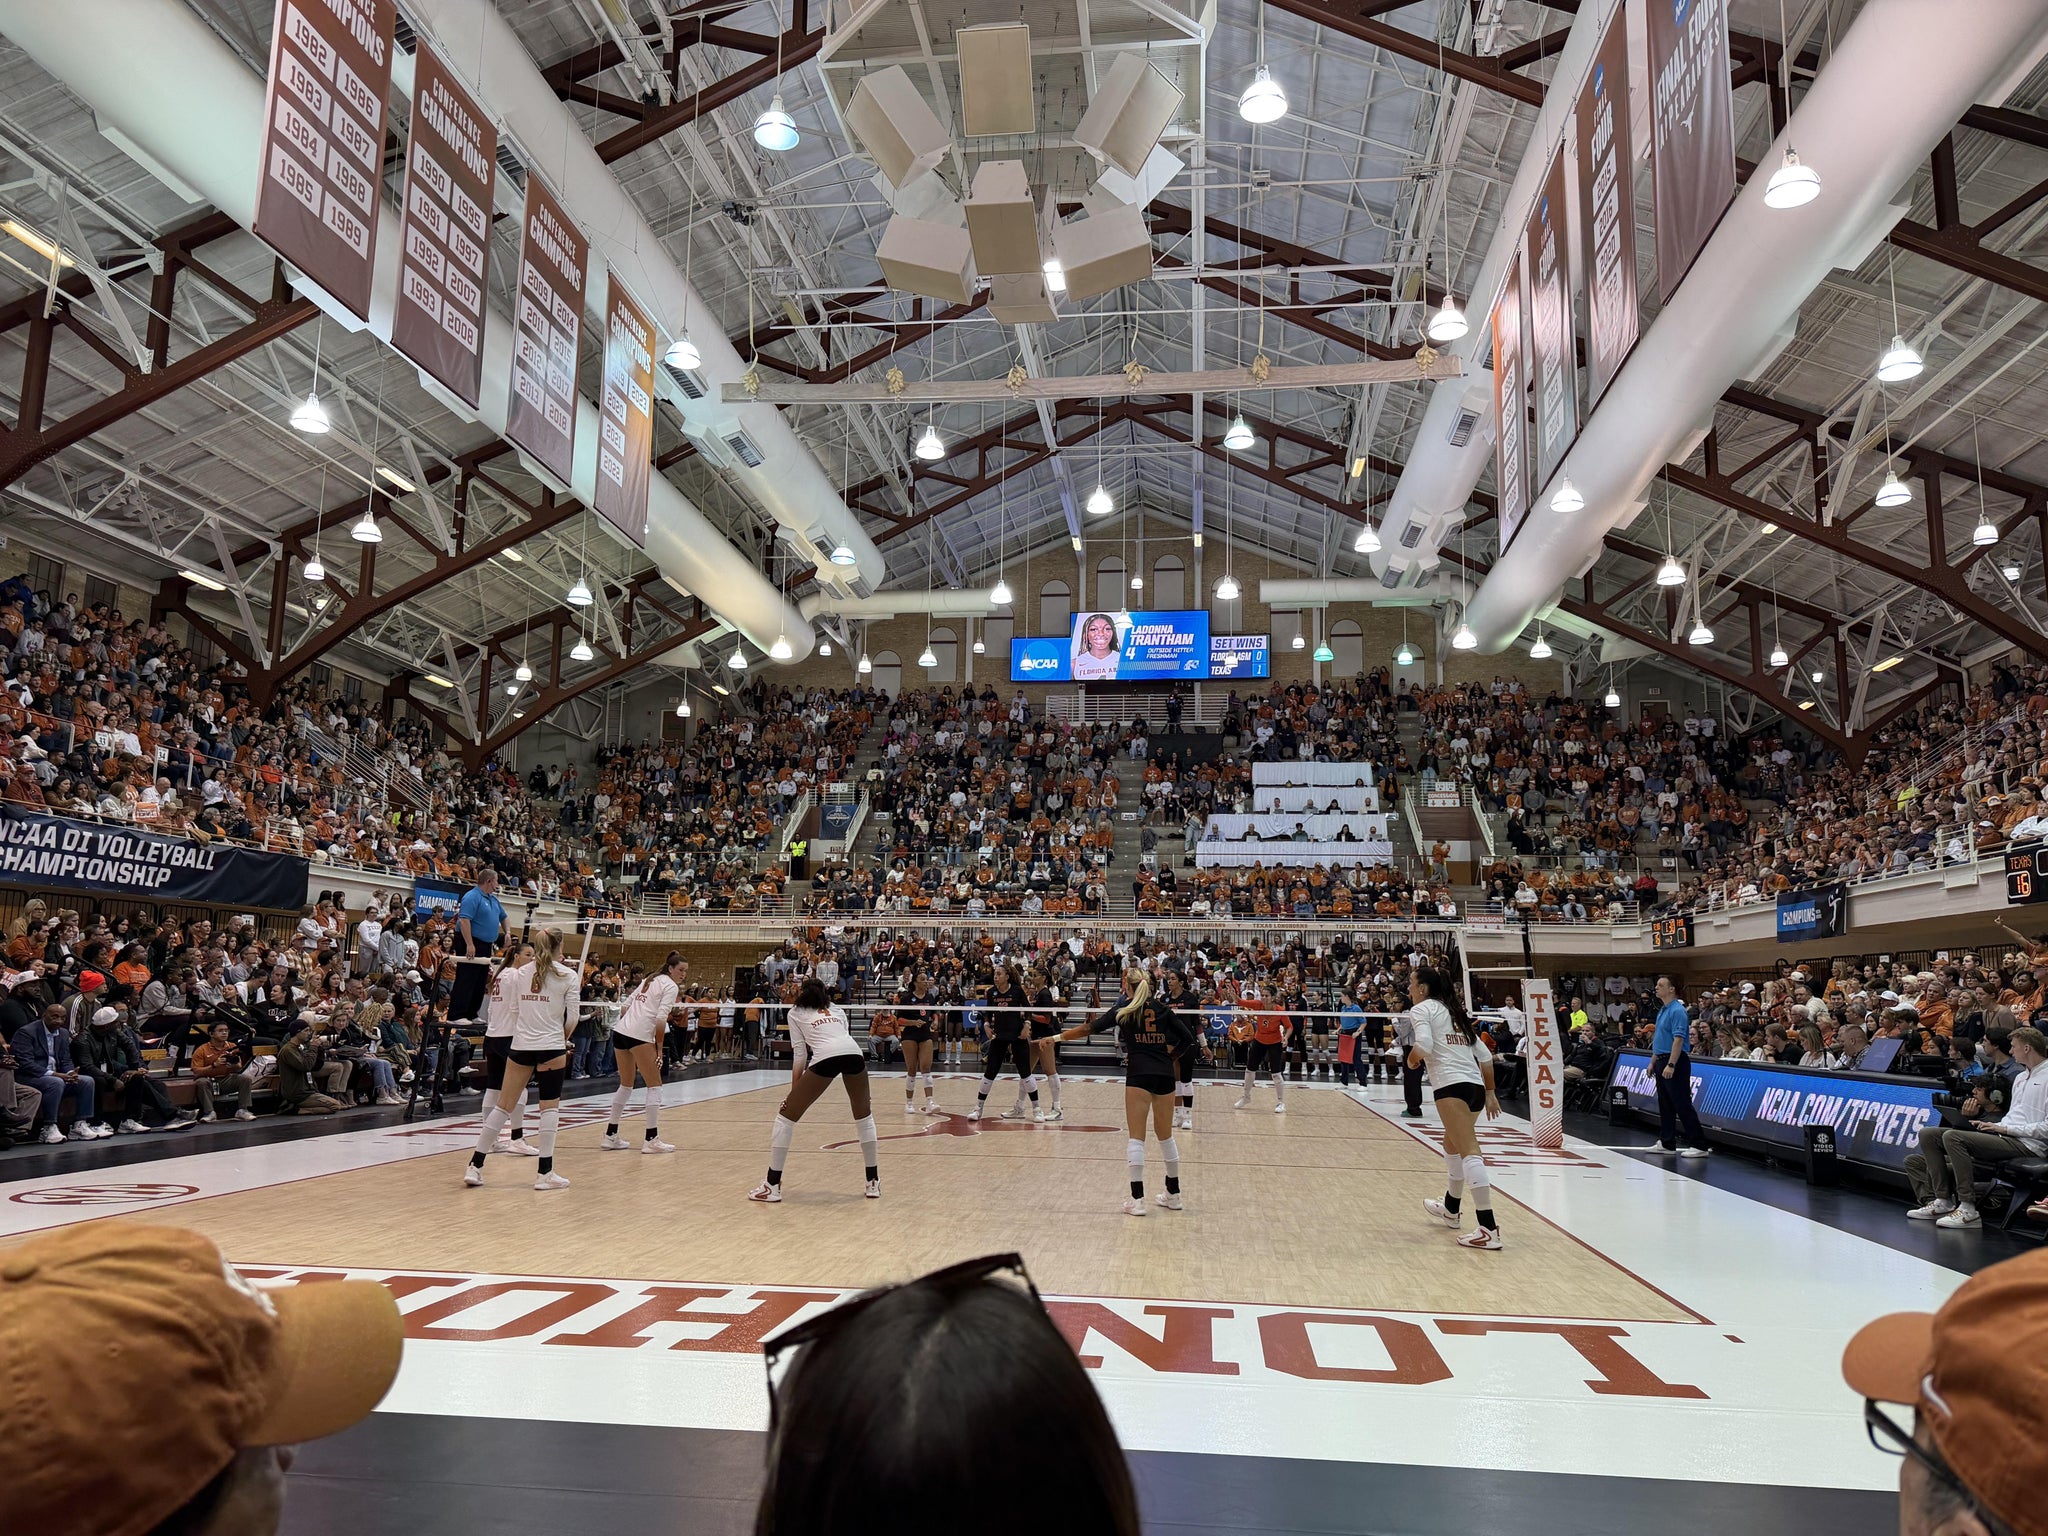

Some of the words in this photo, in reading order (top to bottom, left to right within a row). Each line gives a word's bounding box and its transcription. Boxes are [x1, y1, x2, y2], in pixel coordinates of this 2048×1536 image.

[295, 19, 327, 68] 1982
[322, 0, 384, 67] MPIONS
[290, 65, 322, 111] 1983
[344, 73, 373, 117] 1986
[1657, 37, 1687, 119] FINAL
[1660, 17, 1720, 151] APPEARANCES
[433, 77, 481, 148] CONFERENCE
[285, 112, 317, 158] 1984
[340, 117, 370, 159] 1987
[420, 90, 489, 185] CHAMPIONS
[1591, 101, 1613, 173] FOUR
[280, 159, 313, 206] 1985
[335, 161, 366, 203] 1988
[420, 154, 445, 193] 1990
[330, 204, 362, 247] 1989
[418, 197, 441, 232] 1991
[457, 199, 481, 229] 1995
[539, 203, 577, 259] CONFERENCE
[413, 236, 439, 271] 1992
[455, 233, 478, 267] 1997
[530, 214, 581, 292] CHAMPIONS
[410, 277, 435, 312] 1993
[450, 271, 477, 306] 2007
[527, 270, 548, 302] 2009
[447, 315, 473, 346] 2008
[526, 311, 544, 336] 2011
[556, 302, 574, 332] 2014
[617, 300, 648, 346] CONFERENCE
[610, 311, 651, 375] CHAMPIONS
[520, 376, 539, 404] 2013
[551, 370, 570, 397] 2017
[548, 404, 567, 430] 2018
[1130, 634, 1194, 646] TRANTHAM
[1131, 625, 1173, 634] LADONNA
[1215, 638, 1234, 648] SET
[1236, 638, 1263, 648] WINS
[1125, 647, 1136, 660] 4
[1211, 666, 1232, 675] TEXAS
[1257, 665, 1261, 674] 1
[1256, 651, 1262, 660] 0
[97, 834, 215, 871] VOLLEYBALL
[2010, 854, 2032, 869] TEXAS
[2017, 873, 2030, 895] 16
[1783, 908, 1815, 925] CHAMPIONS
[1135, 1033, 1166, 1043] HALTER
[1144, 1009, 1157, 1032] 2
[1530, 994, 1556, 1108] TEXAS
